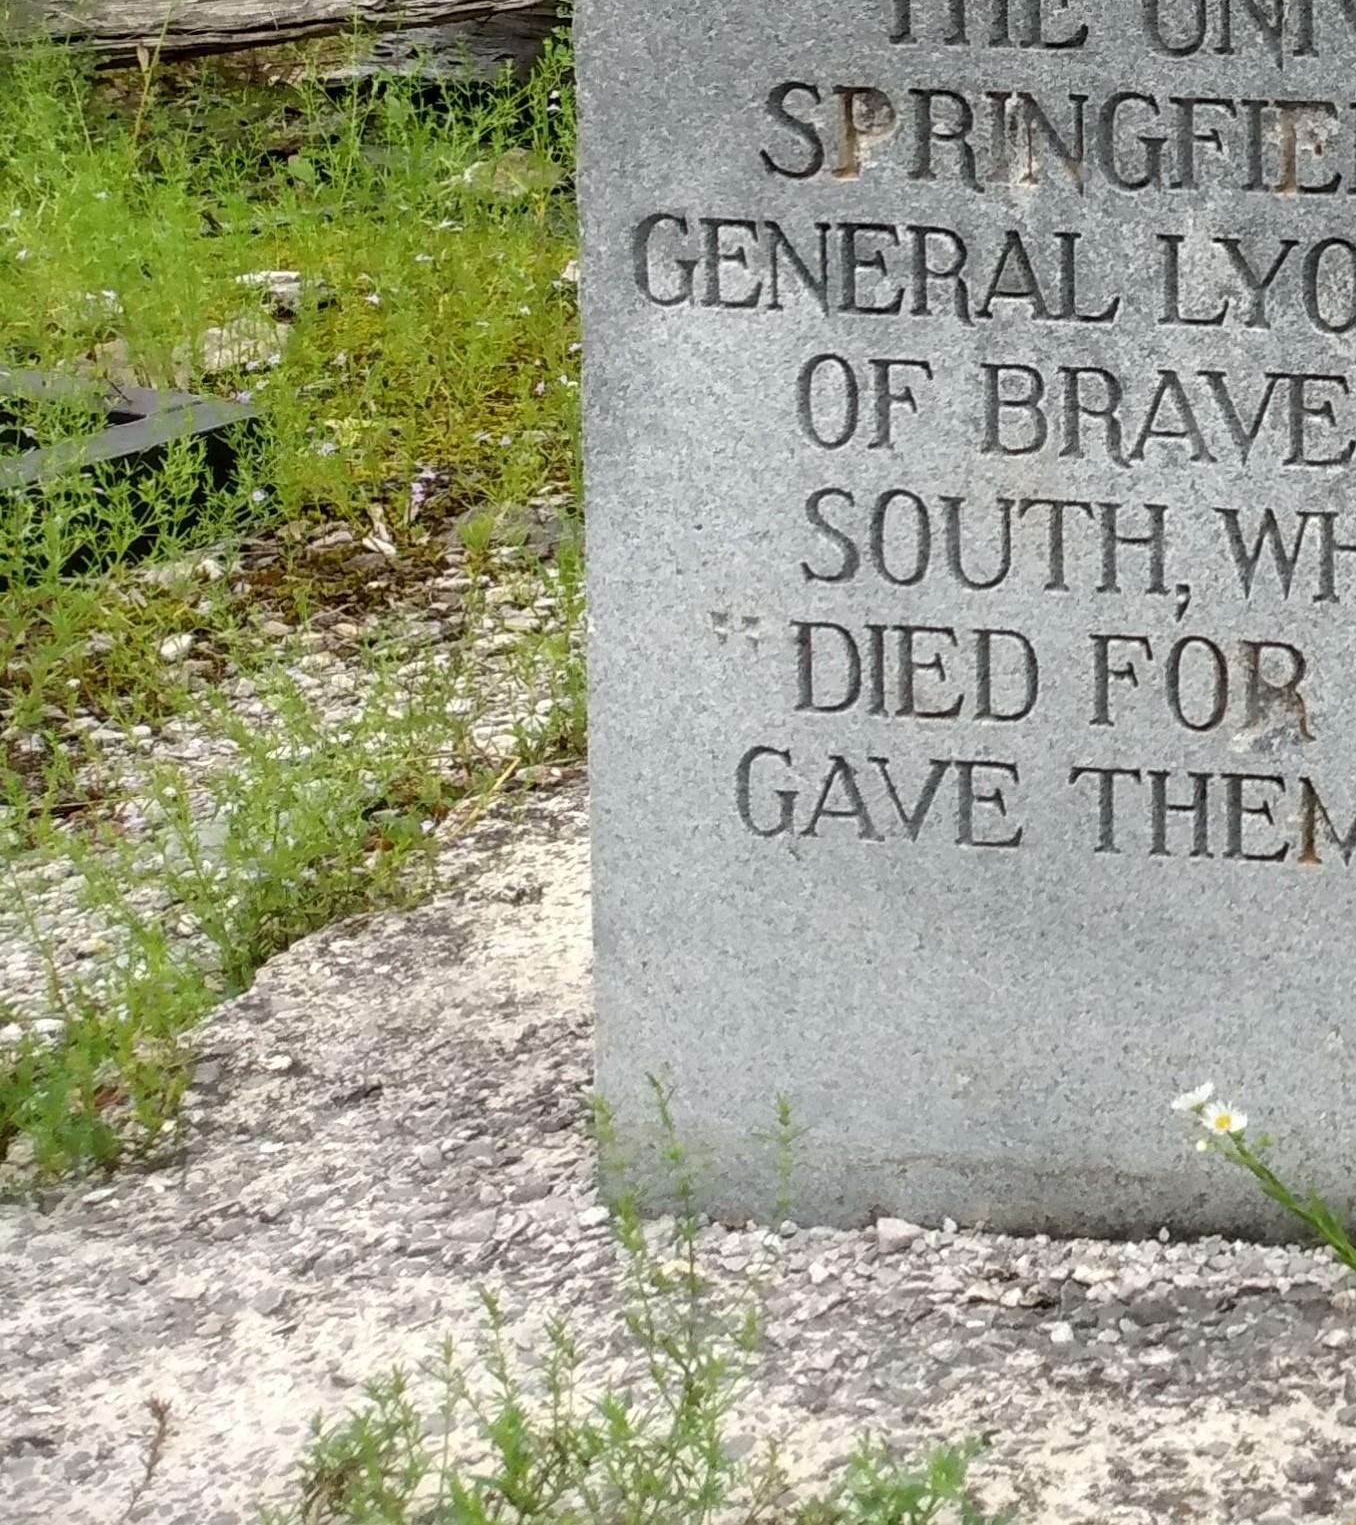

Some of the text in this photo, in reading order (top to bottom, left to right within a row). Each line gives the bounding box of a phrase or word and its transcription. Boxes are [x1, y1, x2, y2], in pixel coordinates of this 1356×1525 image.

[631, 212, 1120, 326] GENERAL
[799, 353, 934, 450] OF
[979, 362, 1356, 468] BRAVE
[800, 487, 1191, 621] SOUTH,
[1089, 633, 1316, 743] FOR
[734, 745, 1024, 849] GAVE
